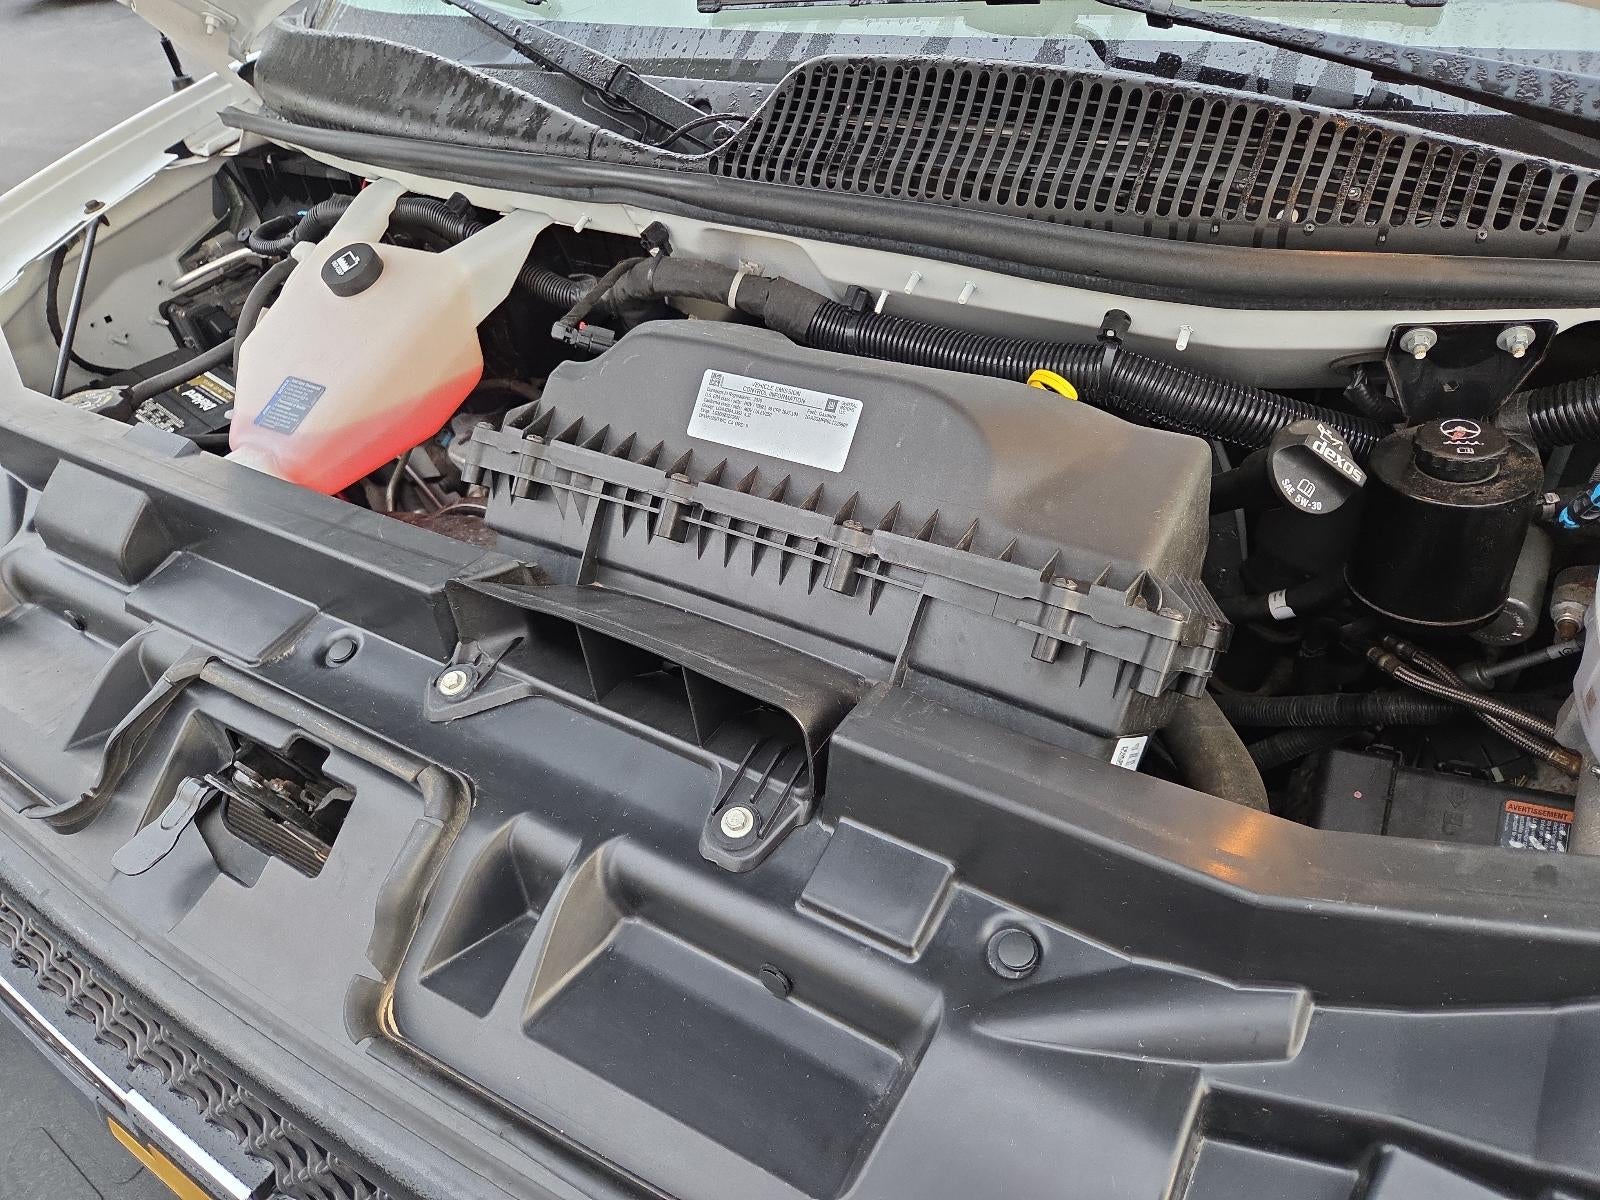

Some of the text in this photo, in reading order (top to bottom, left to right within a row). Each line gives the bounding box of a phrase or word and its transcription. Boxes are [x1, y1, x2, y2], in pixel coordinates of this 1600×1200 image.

[743, 385, 767, 396] CONTROL
[1312, 440, 1363, 483] dexos
[1281, 478, 1322, 511] SAE 5W-30
[1507, 803, 1569, 821] AVERTISSEMENT
